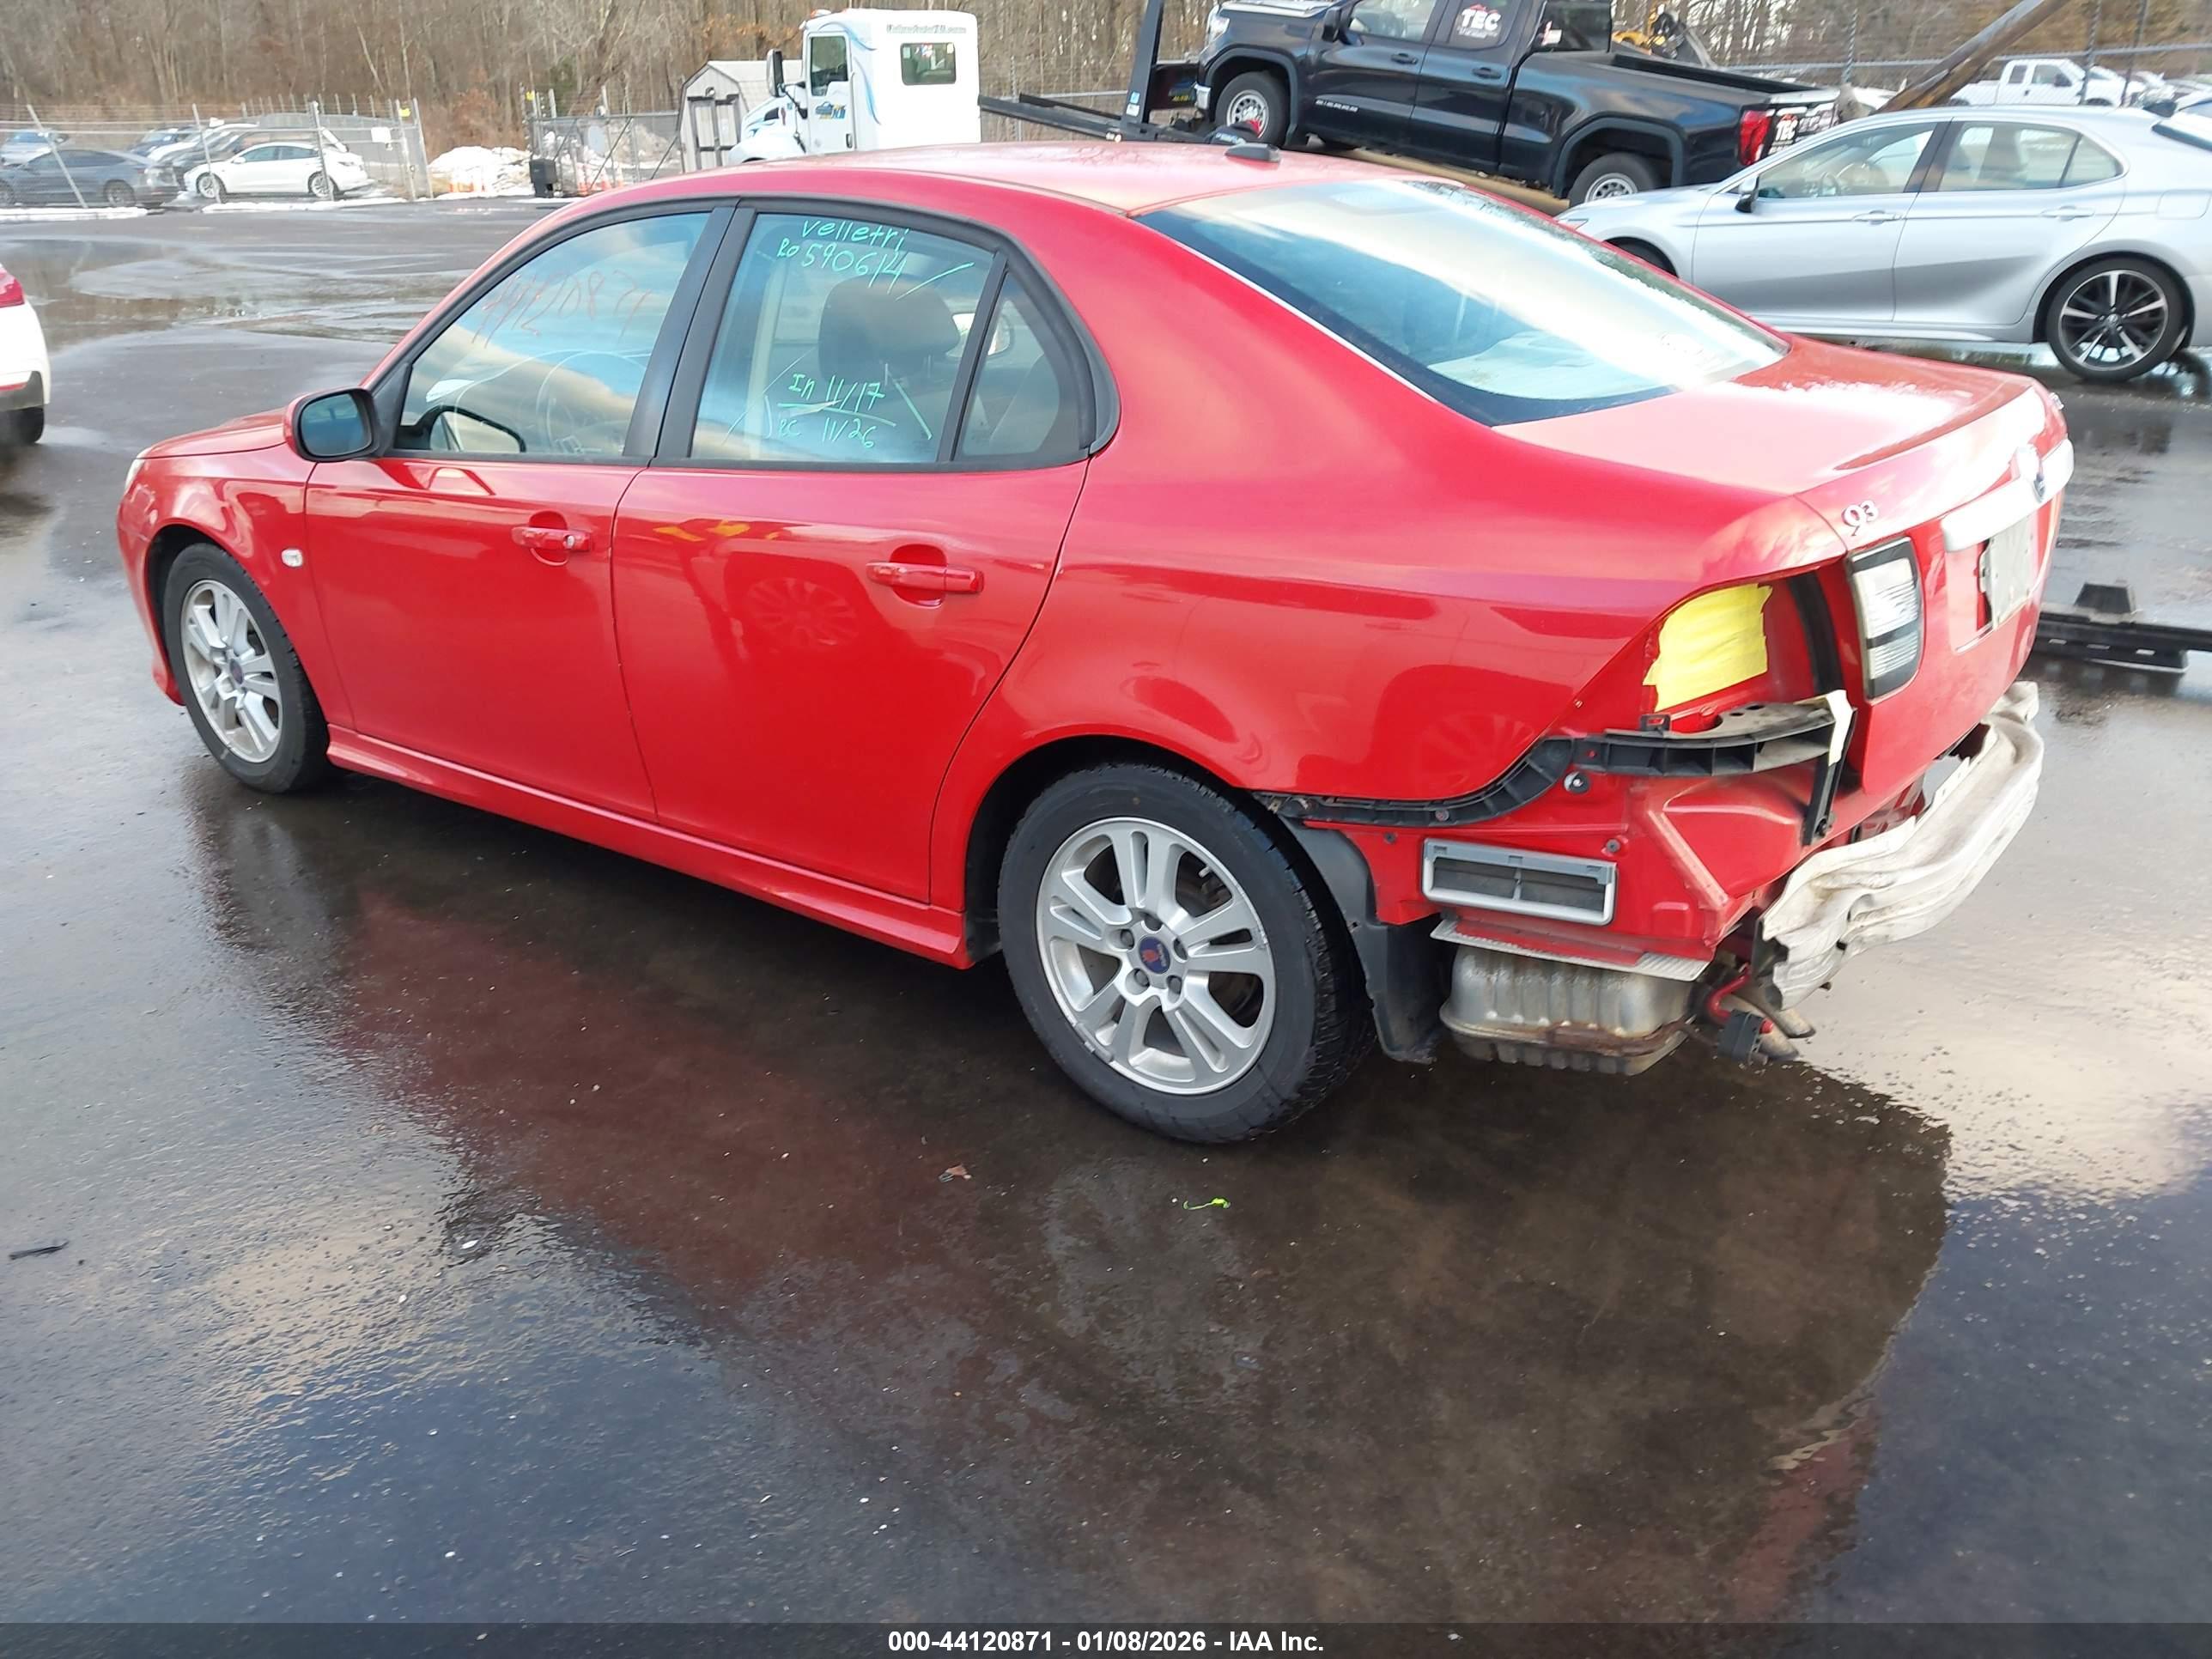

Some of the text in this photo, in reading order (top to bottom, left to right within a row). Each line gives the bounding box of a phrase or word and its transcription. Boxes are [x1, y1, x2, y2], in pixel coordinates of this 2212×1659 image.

[1461, 8, 1501, 31] TEC
[801, 241, 907, 295] 590614
[826, 375, 885, 413] 11/17
[822, 416, 877, 448] 11/26
